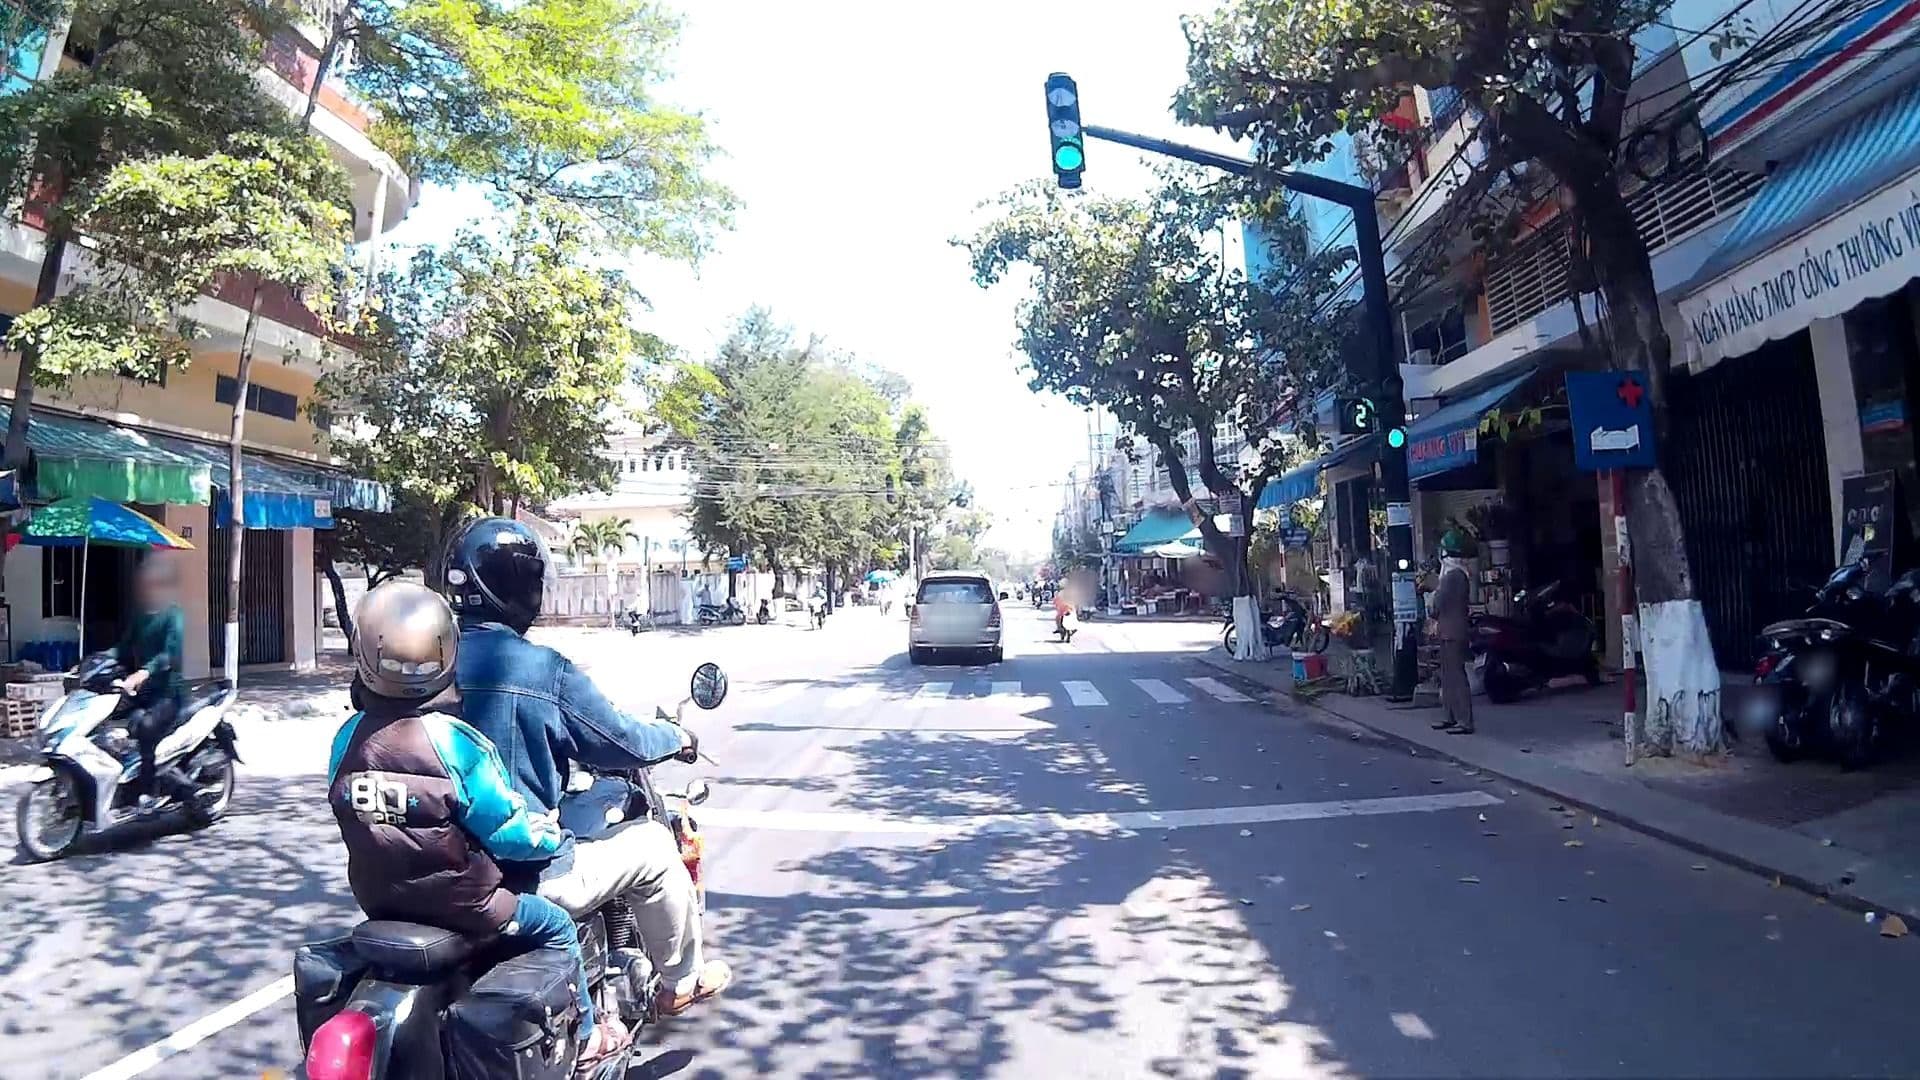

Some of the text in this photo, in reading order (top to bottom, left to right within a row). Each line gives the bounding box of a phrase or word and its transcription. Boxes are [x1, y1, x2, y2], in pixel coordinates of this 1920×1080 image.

[1692, 299, 1728, 345] NGÂN
[1728, 285, 1764, 334] HÀNG
[1761, 270, 1797, 317] TMCP
[1798, 247, 1840, 300] CÔNG
[1837, 216, 1904, 281] THƯƠNG
[1355, 404, 1367, 428] 2
